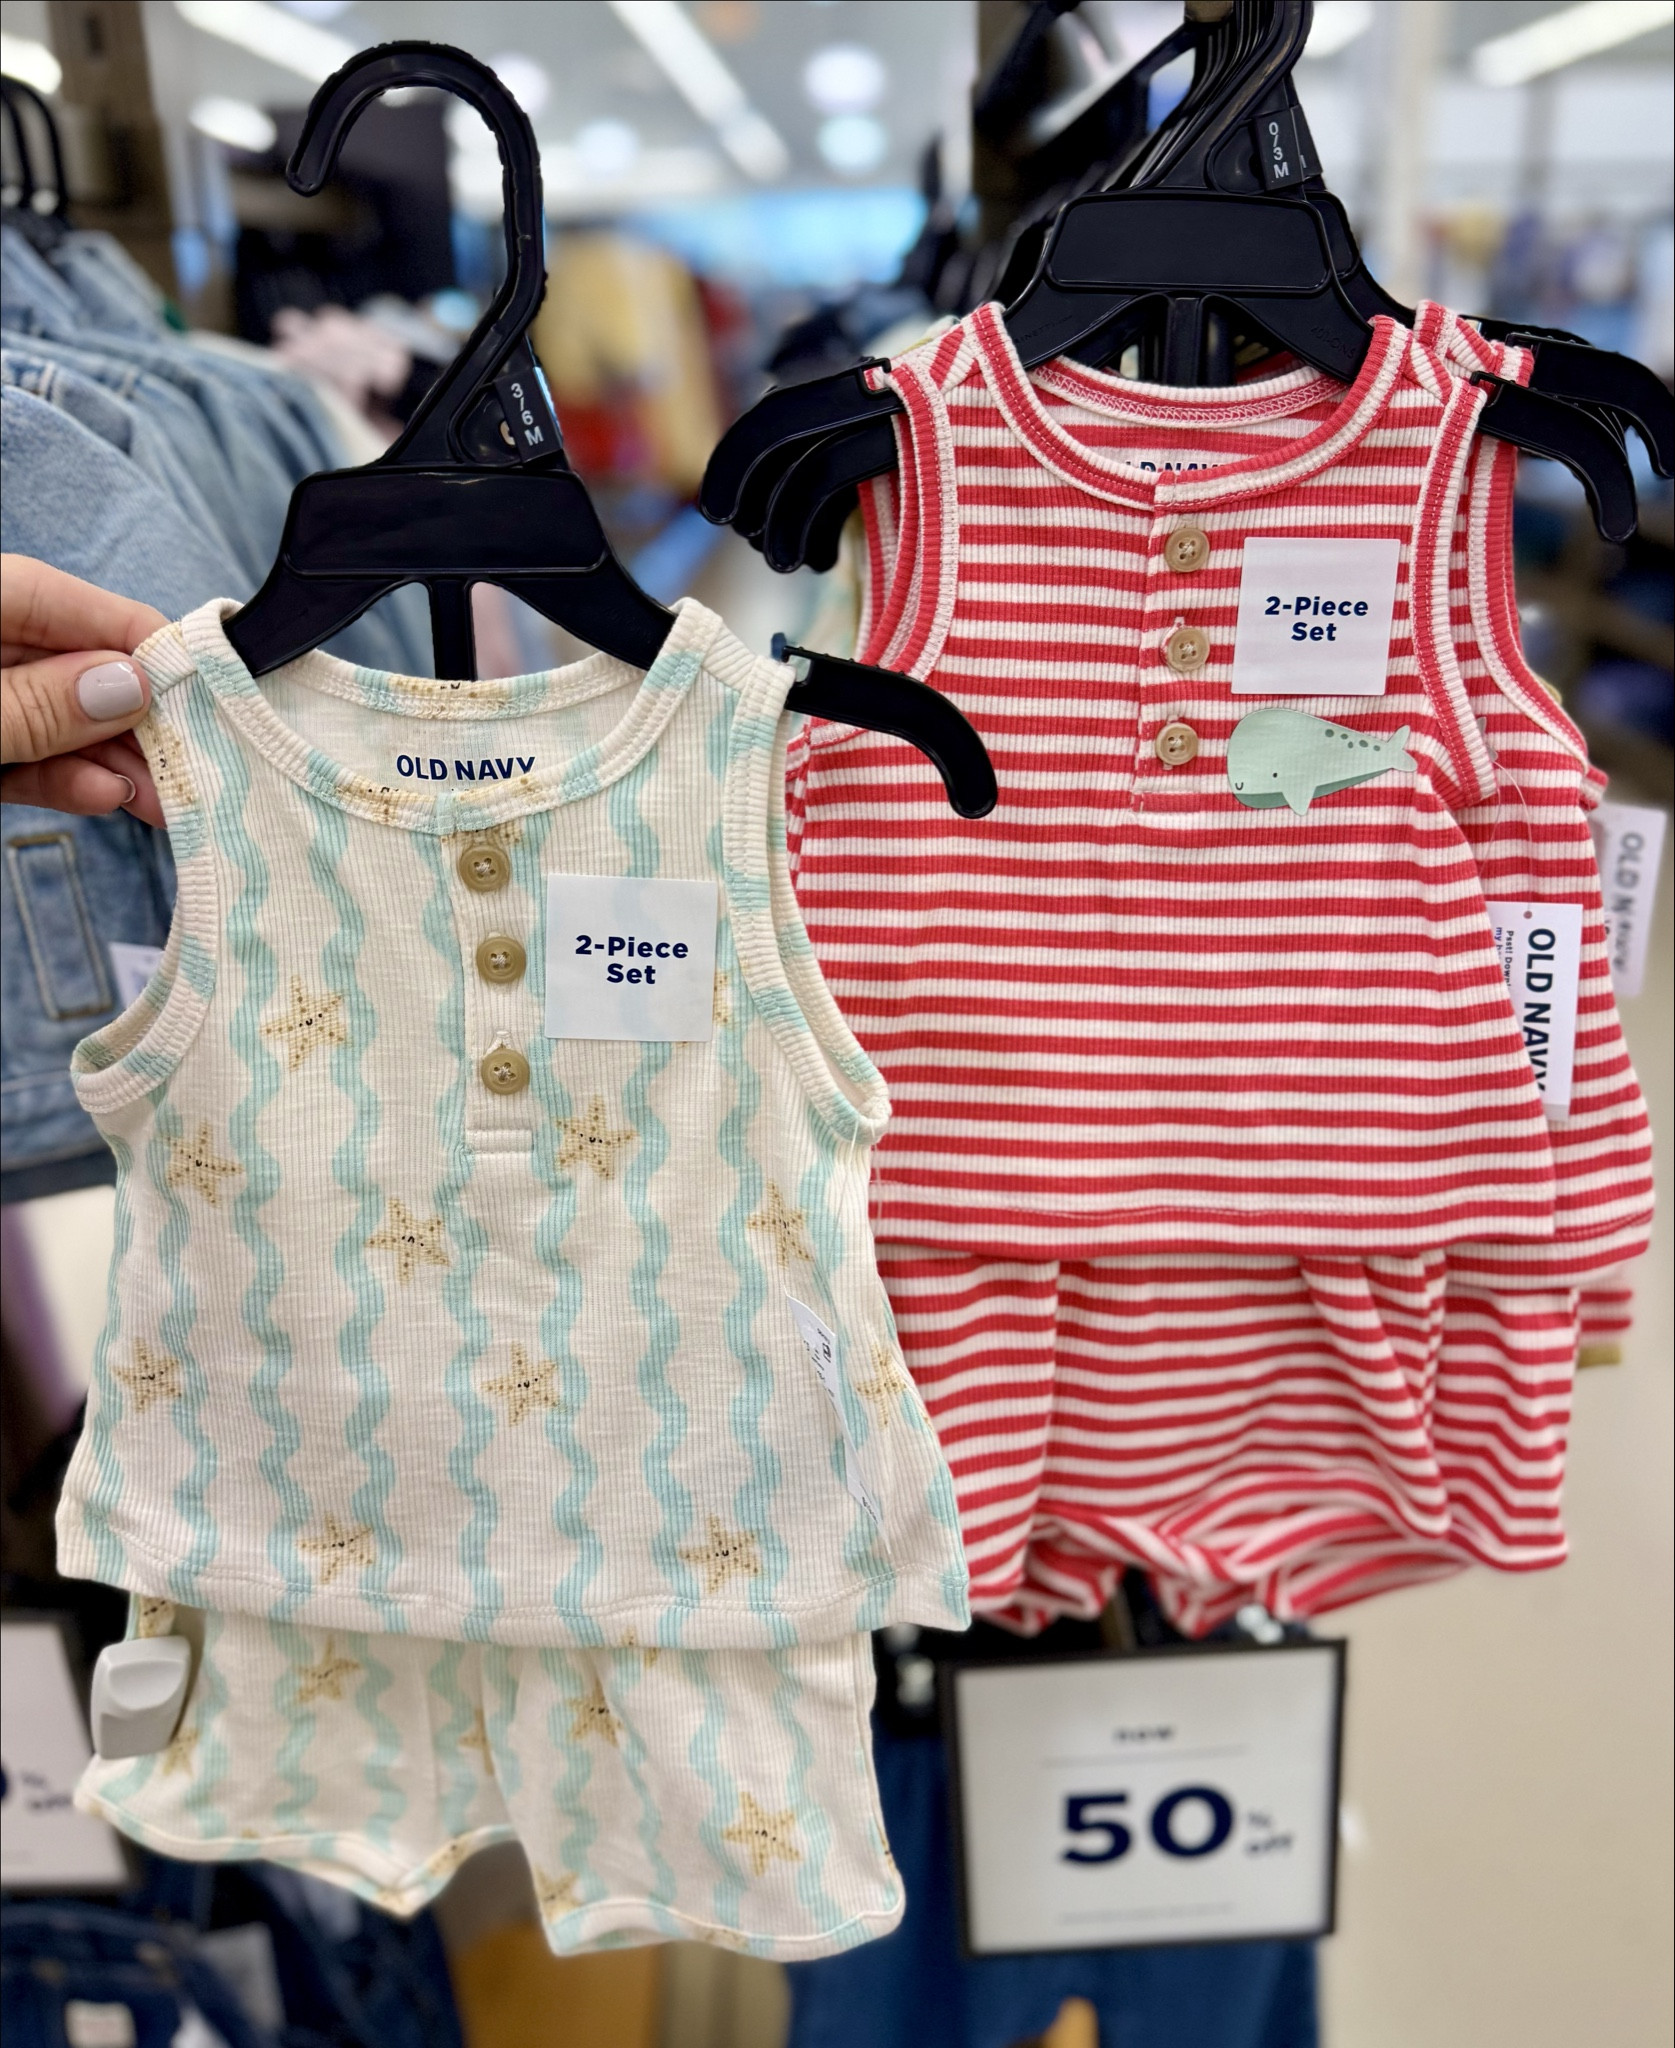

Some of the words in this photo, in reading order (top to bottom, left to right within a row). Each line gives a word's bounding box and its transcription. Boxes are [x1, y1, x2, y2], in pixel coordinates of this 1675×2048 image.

[1264, 595, 1369, 617] 2-Piece
[1290, 621, 1337, 642] Set
[396, 754, 448, 781] OLD
[454, 756, 536, 781] NAVY
[575, 934, 689, 959] 2-Piece
[1525, 927, 1556, 994] OLD
[606, 962, 657, 985] Set
[1060, 1784, 1235, 1866] 50
